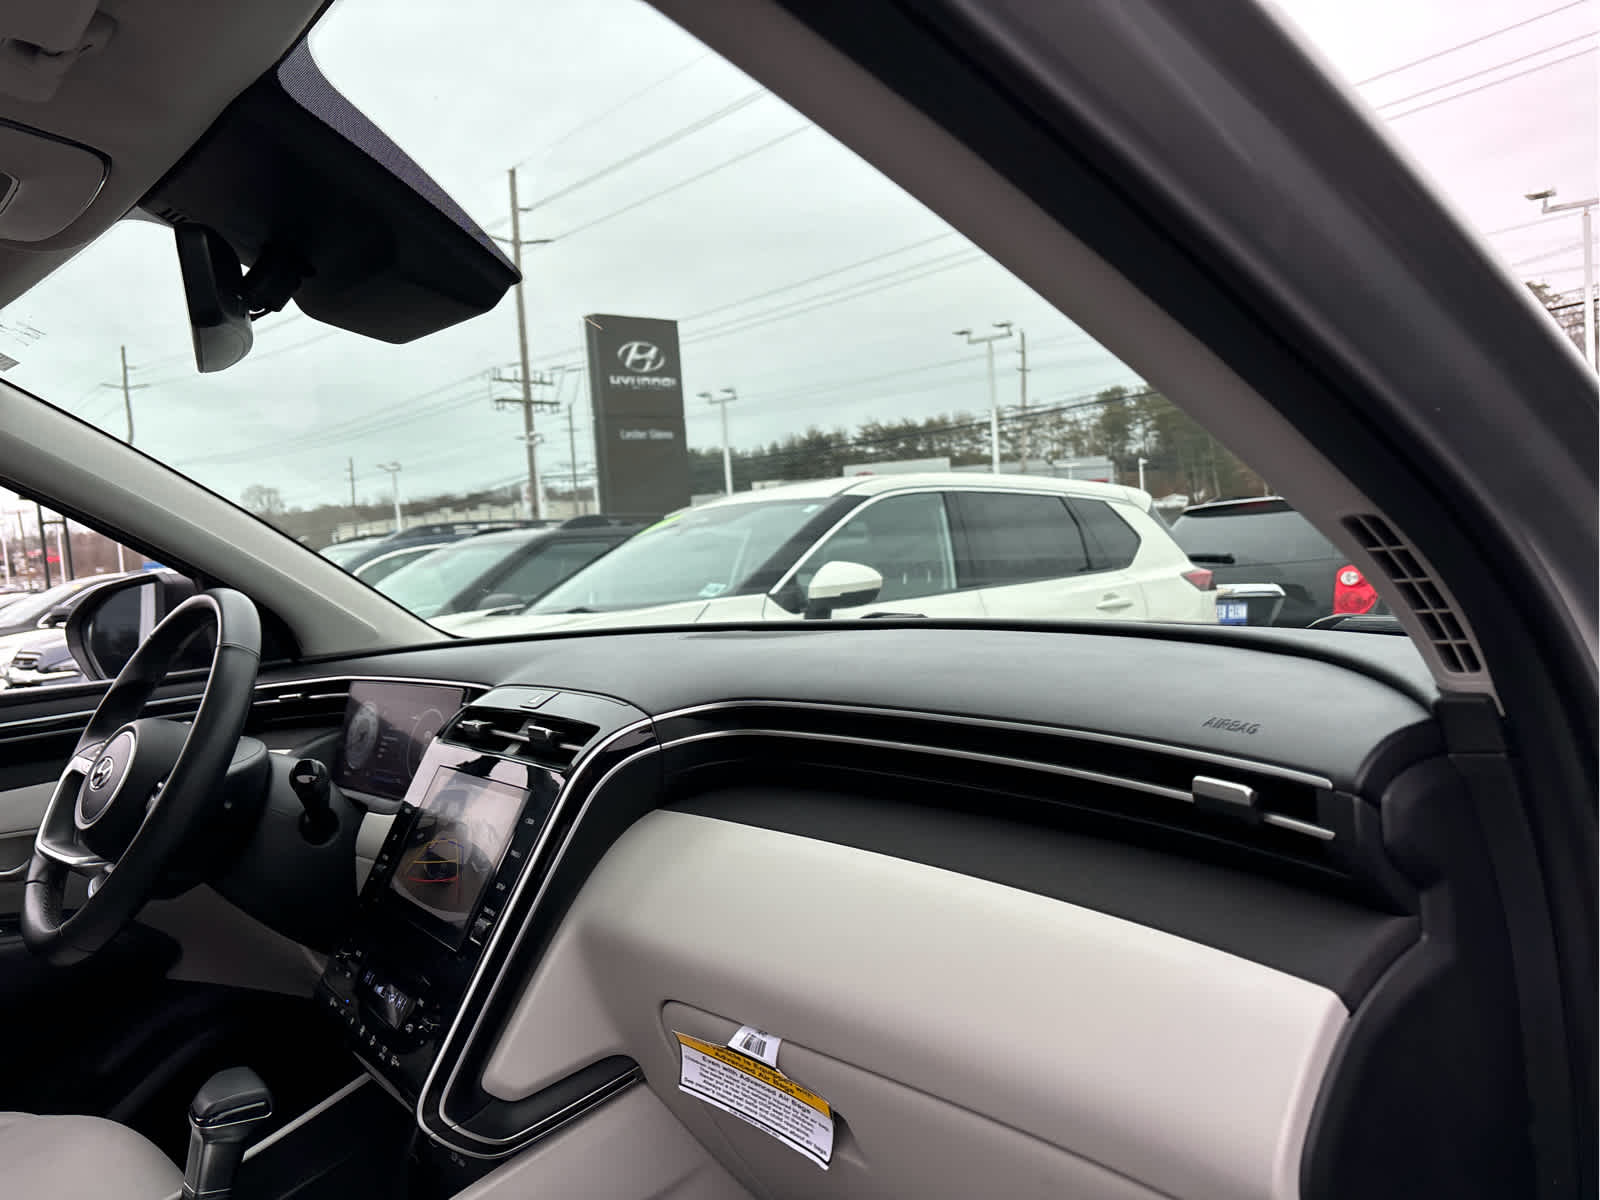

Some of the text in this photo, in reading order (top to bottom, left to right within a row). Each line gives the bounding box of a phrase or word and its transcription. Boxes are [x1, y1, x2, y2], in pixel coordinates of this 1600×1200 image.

[609, 375, 677, 388] HYUNDAI
[1202, 717, 1261, 735] AIRBAG
[702, 1054, 810, 1115] Even with Advanced Air Bags
